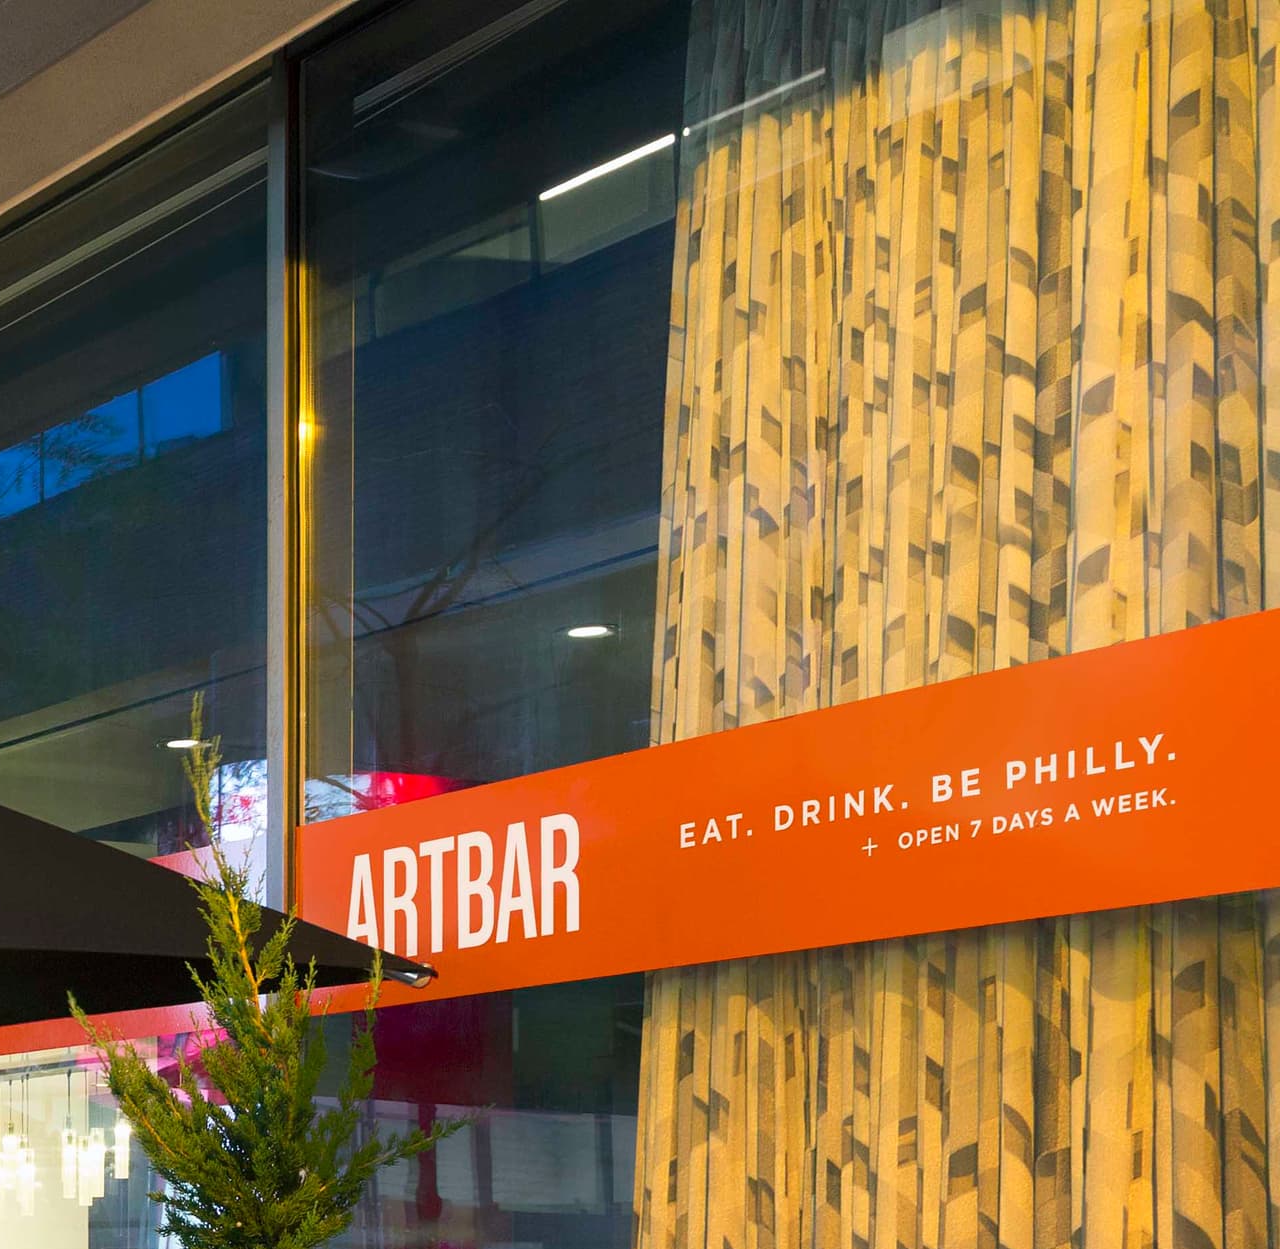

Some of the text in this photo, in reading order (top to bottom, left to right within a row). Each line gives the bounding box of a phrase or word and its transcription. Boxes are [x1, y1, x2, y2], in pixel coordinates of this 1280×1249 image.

[679, 733, 1176, 849] EAT. DRINK. BE PHILLY.
[897, 824, 959, 850] OPEN
[970, 820, 982, 838] 7
[992, 808, 1053, 835] DAYS
[1064, 803, 1080, 823] A
[1091, 788, 1176, 817] WEEK.
[346, 813, 580, 958] ARTBAR
